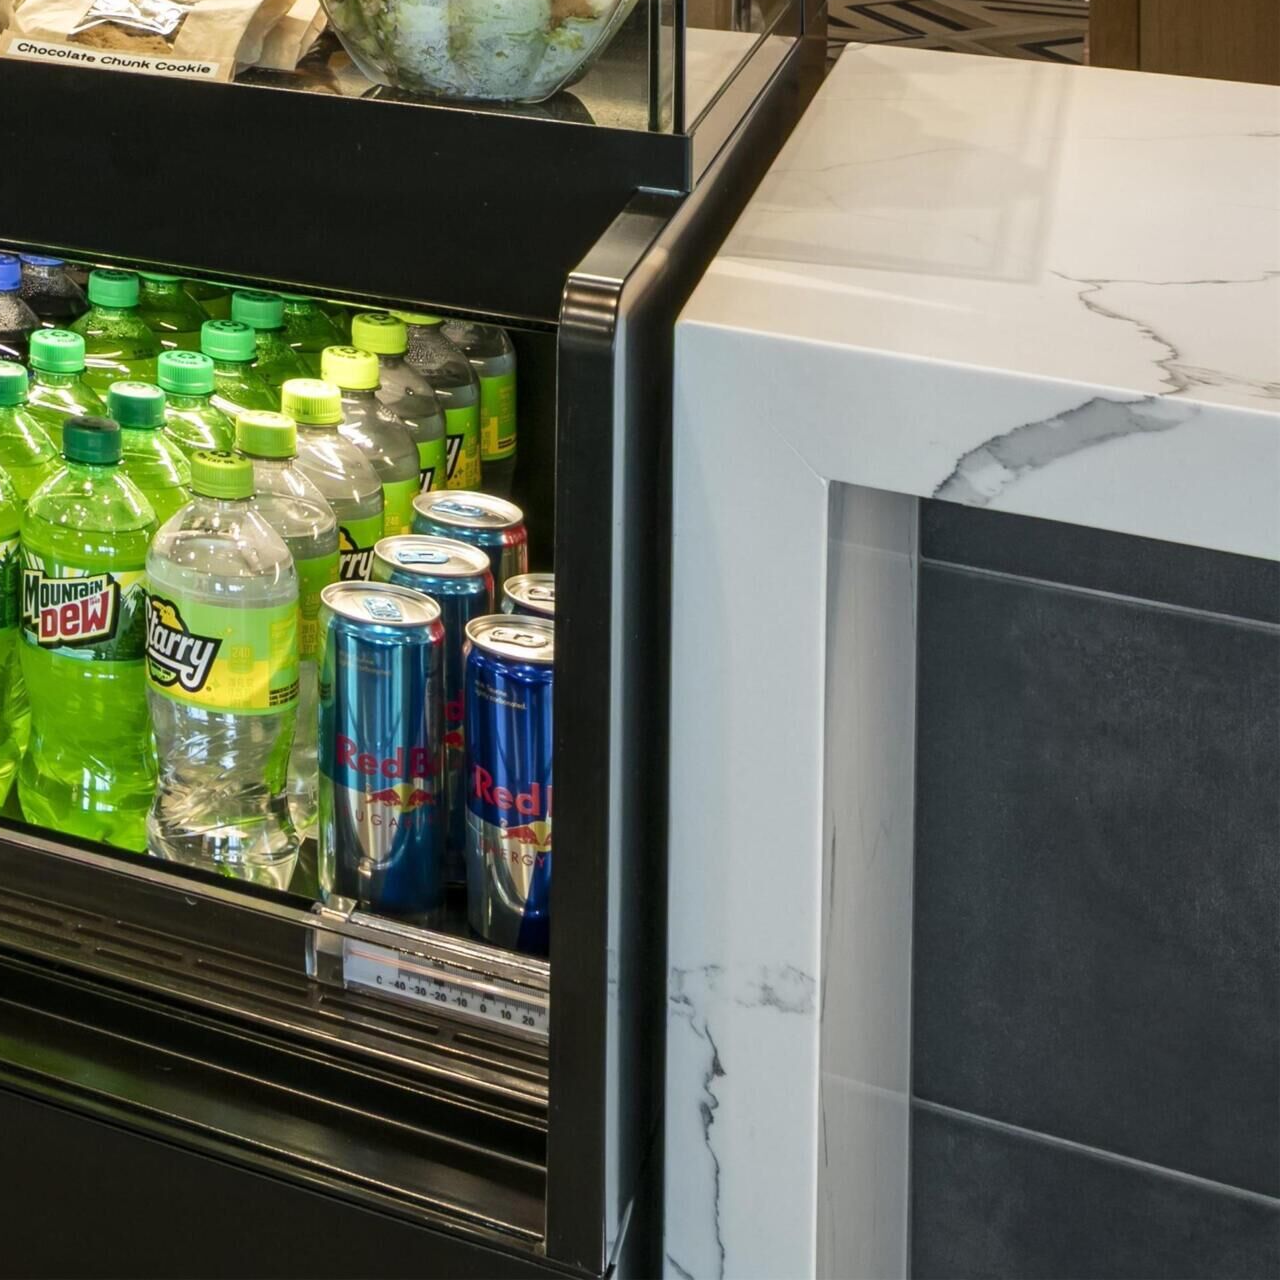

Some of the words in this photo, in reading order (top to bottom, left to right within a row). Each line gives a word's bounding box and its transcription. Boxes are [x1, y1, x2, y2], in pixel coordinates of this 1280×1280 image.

[17, 42, 95, 65] Chocolate
[101, 55, 150, 71] Chunk
[155, 61, 211, 76] Cookie
[340, 551, 374, 581] rry
[145, 595, 216, 688] Starry
[336, 733, 404, 779] Red
[474, 765, 540, 817] Red
[389, 980, 407, 991] -40
[410, 985, 427, 997] -30
[430, 991, 447, 1003] -20
[451, 997, 468, 1008] -10
[480, 1004, 487, 1013] 0
[501, 1009, 512, 1020] 10
[522, 1015, 535, 1027] 20
